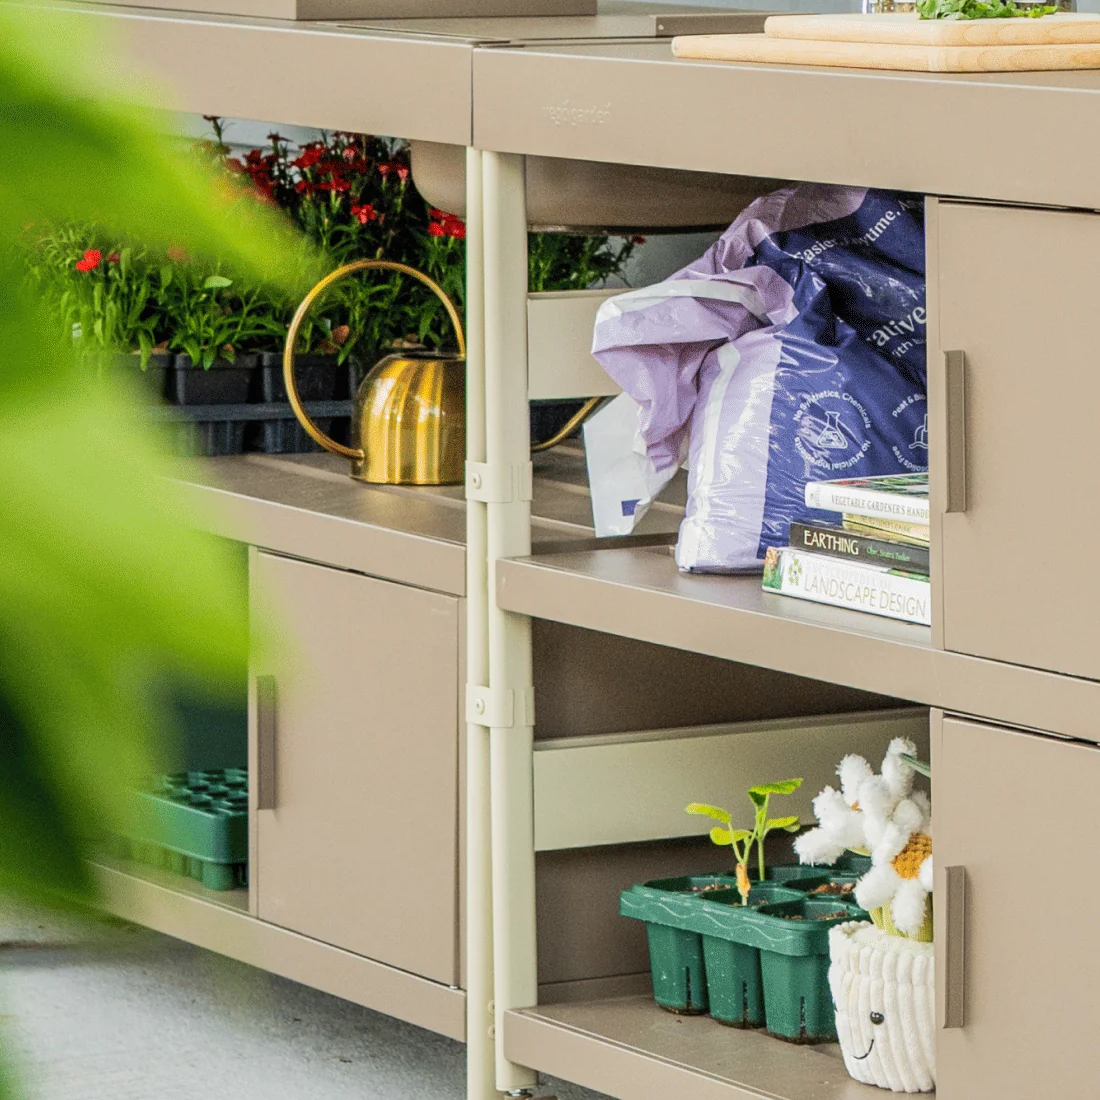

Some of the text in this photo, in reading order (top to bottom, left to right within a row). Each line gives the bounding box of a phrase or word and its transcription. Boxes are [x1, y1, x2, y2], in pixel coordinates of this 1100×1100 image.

[867, 306, 927, 347] ative
[842, 393, 871, 429] Chemicals
[831, 494, 866, 509] VEGETABLE
[803, 529, 859, 555] EARTHING
[804, 573, 926, 619] LANDSCAPE DESIGN
